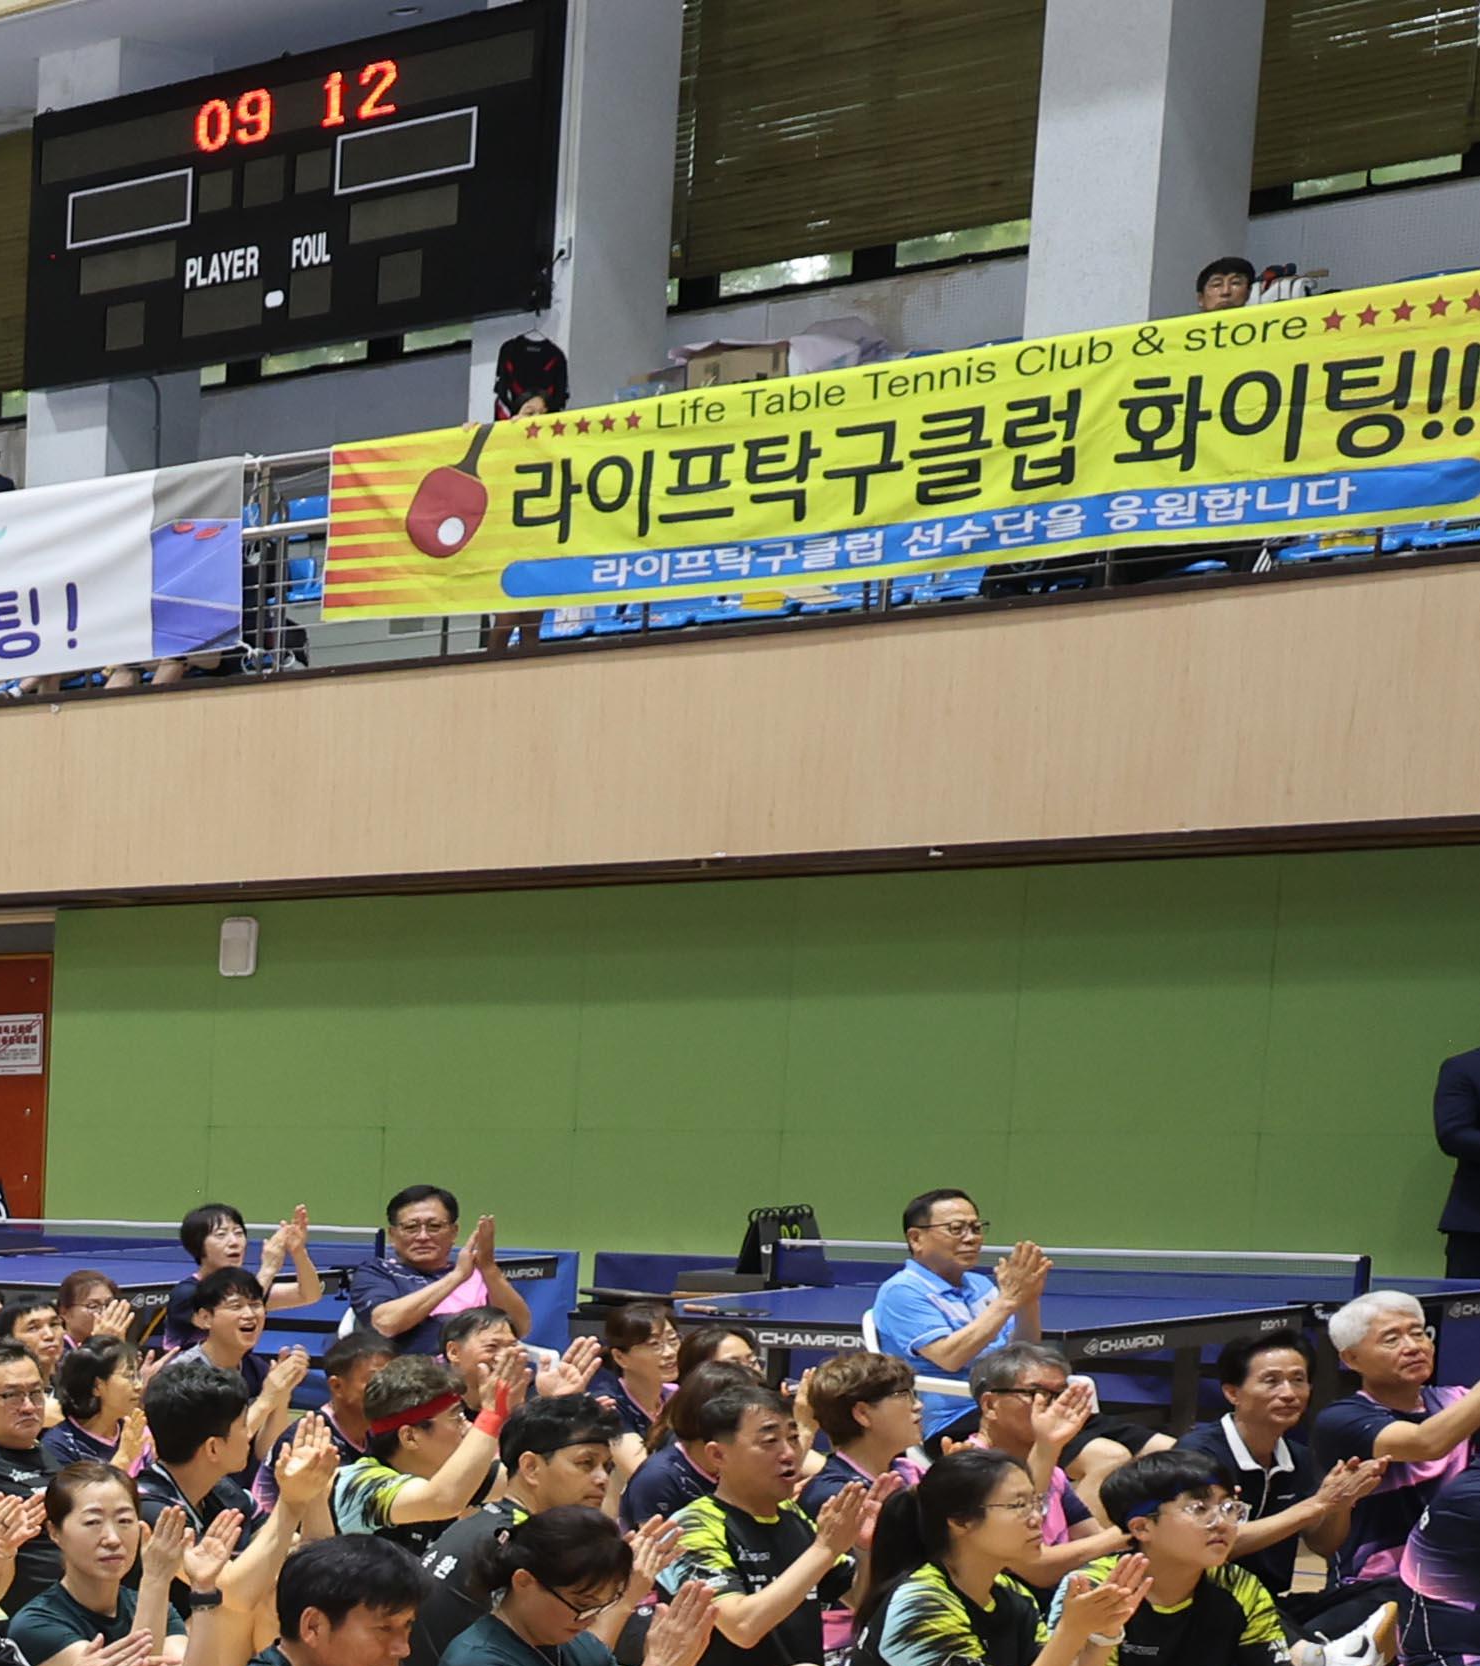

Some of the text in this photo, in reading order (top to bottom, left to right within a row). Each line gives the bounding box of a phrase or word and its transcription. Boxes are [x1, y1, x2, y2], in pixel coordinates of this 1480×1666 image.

[193, 58, 399, 152] 09 12
[184, 231, 331, 289] PLAYER FOUL
[657, 316, 1308, 430] Life Table Tennis Club & store
[512, 388, 1082, 543] 라이프탁구클럽
[592, 477, 1357, 586] 라이프탁구클럽 선수단을 응원합니다
[1099, 1333, 1165, 1354] CHAMPION
